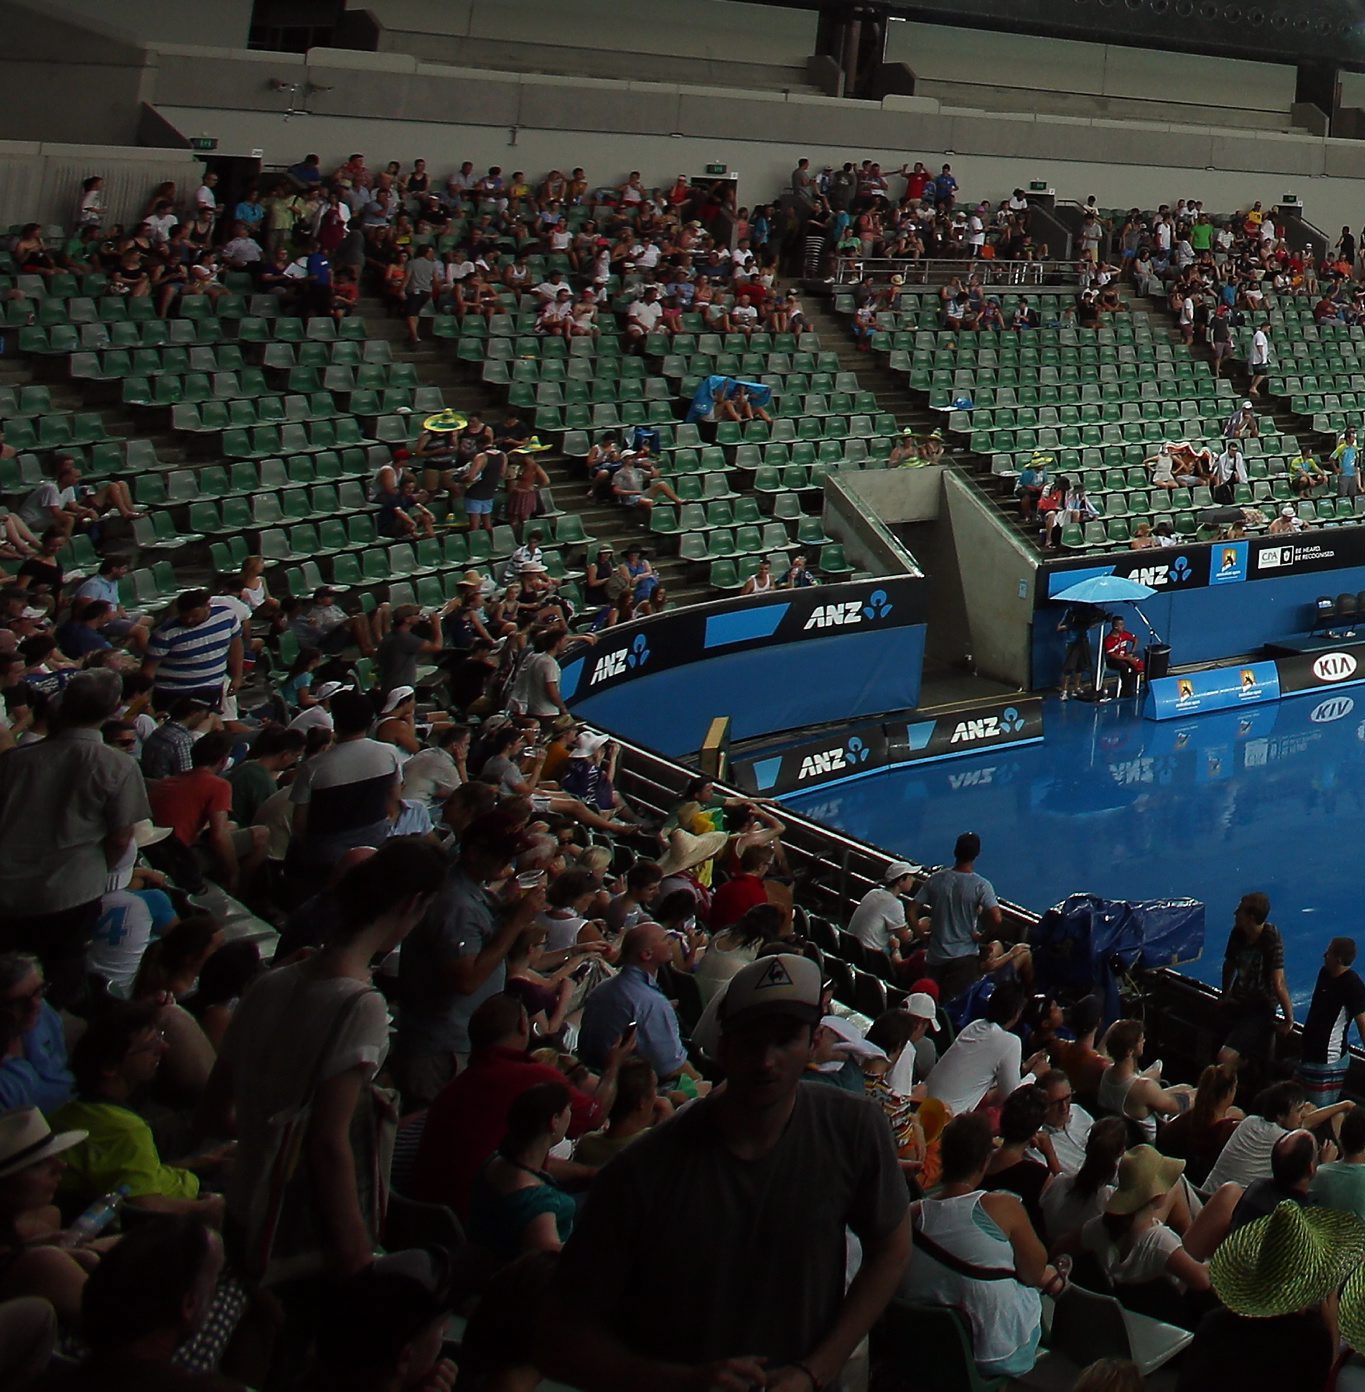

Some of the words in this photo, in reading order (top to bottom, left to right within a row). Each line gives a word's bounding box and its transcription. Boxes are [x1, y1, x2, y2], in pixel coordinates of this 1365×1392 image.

[1262, 552, 1278, 561] CPA
[1127, 565, 1170, 586] ANZ
[803, 602, 862, 630] ANZ
[590, 648, 628, 686] ANZ
[1318, 658, 1352, 678] KIA
[950, 716, 1001, 744] ANZ
[798, 748, 847, 780] ANZ
